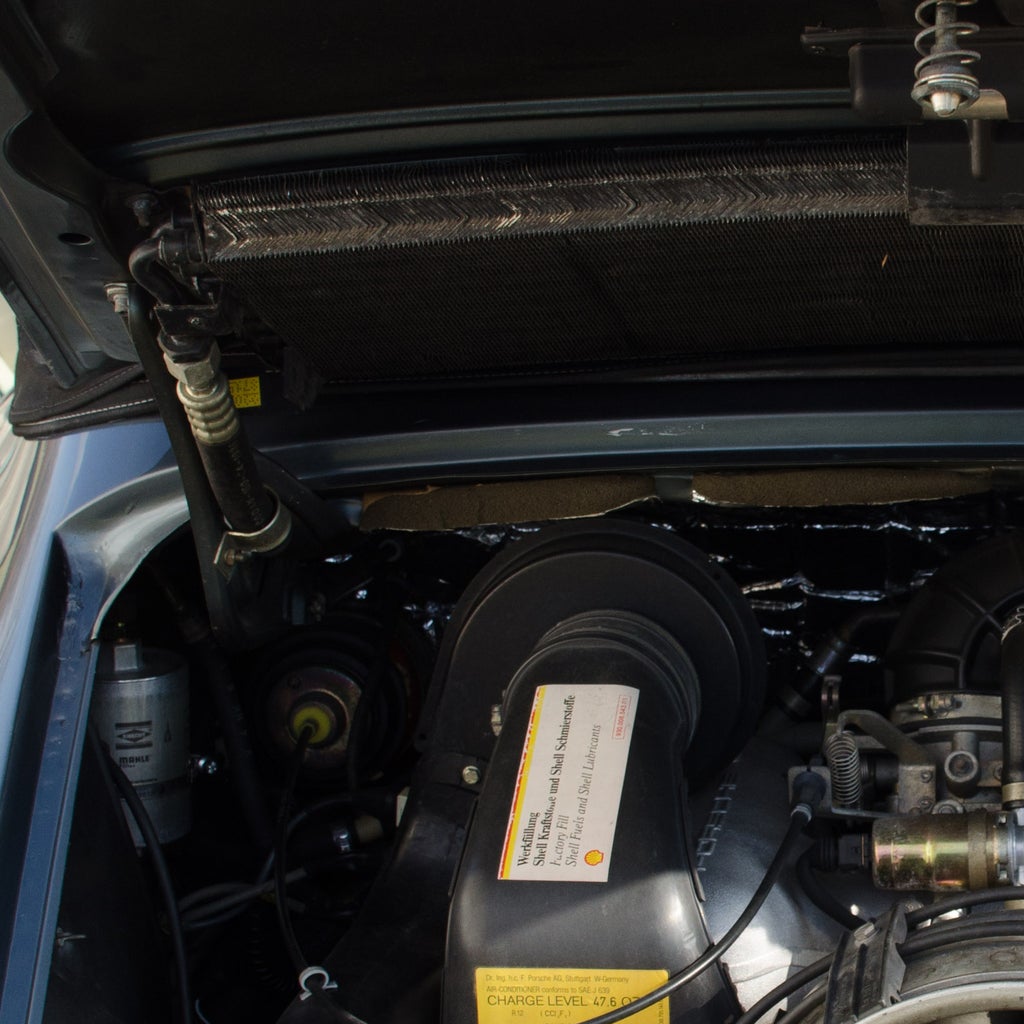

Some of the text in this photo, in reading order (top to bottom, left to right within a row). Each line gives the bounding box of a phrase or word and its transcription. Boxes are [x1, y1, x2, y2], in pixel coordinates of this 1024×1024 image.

[556, 695, 576, 751] Schmierstoffe
[551, 753, 565, 776] Shell
[550, 778, 560, 795] und
[566, 725, 601, 867] Shell Fuels and Shell Lubricants
[557, 815, 570, 830] Fill
[518, 812, 540, 866] Werkfüllung
[533, 838, 548, 866] Shell
[487, 995, 544, 1006] CHARGE
[547, 995, 588, 1007] LEVEL
[593, 996, 617, 1008] 47.6
